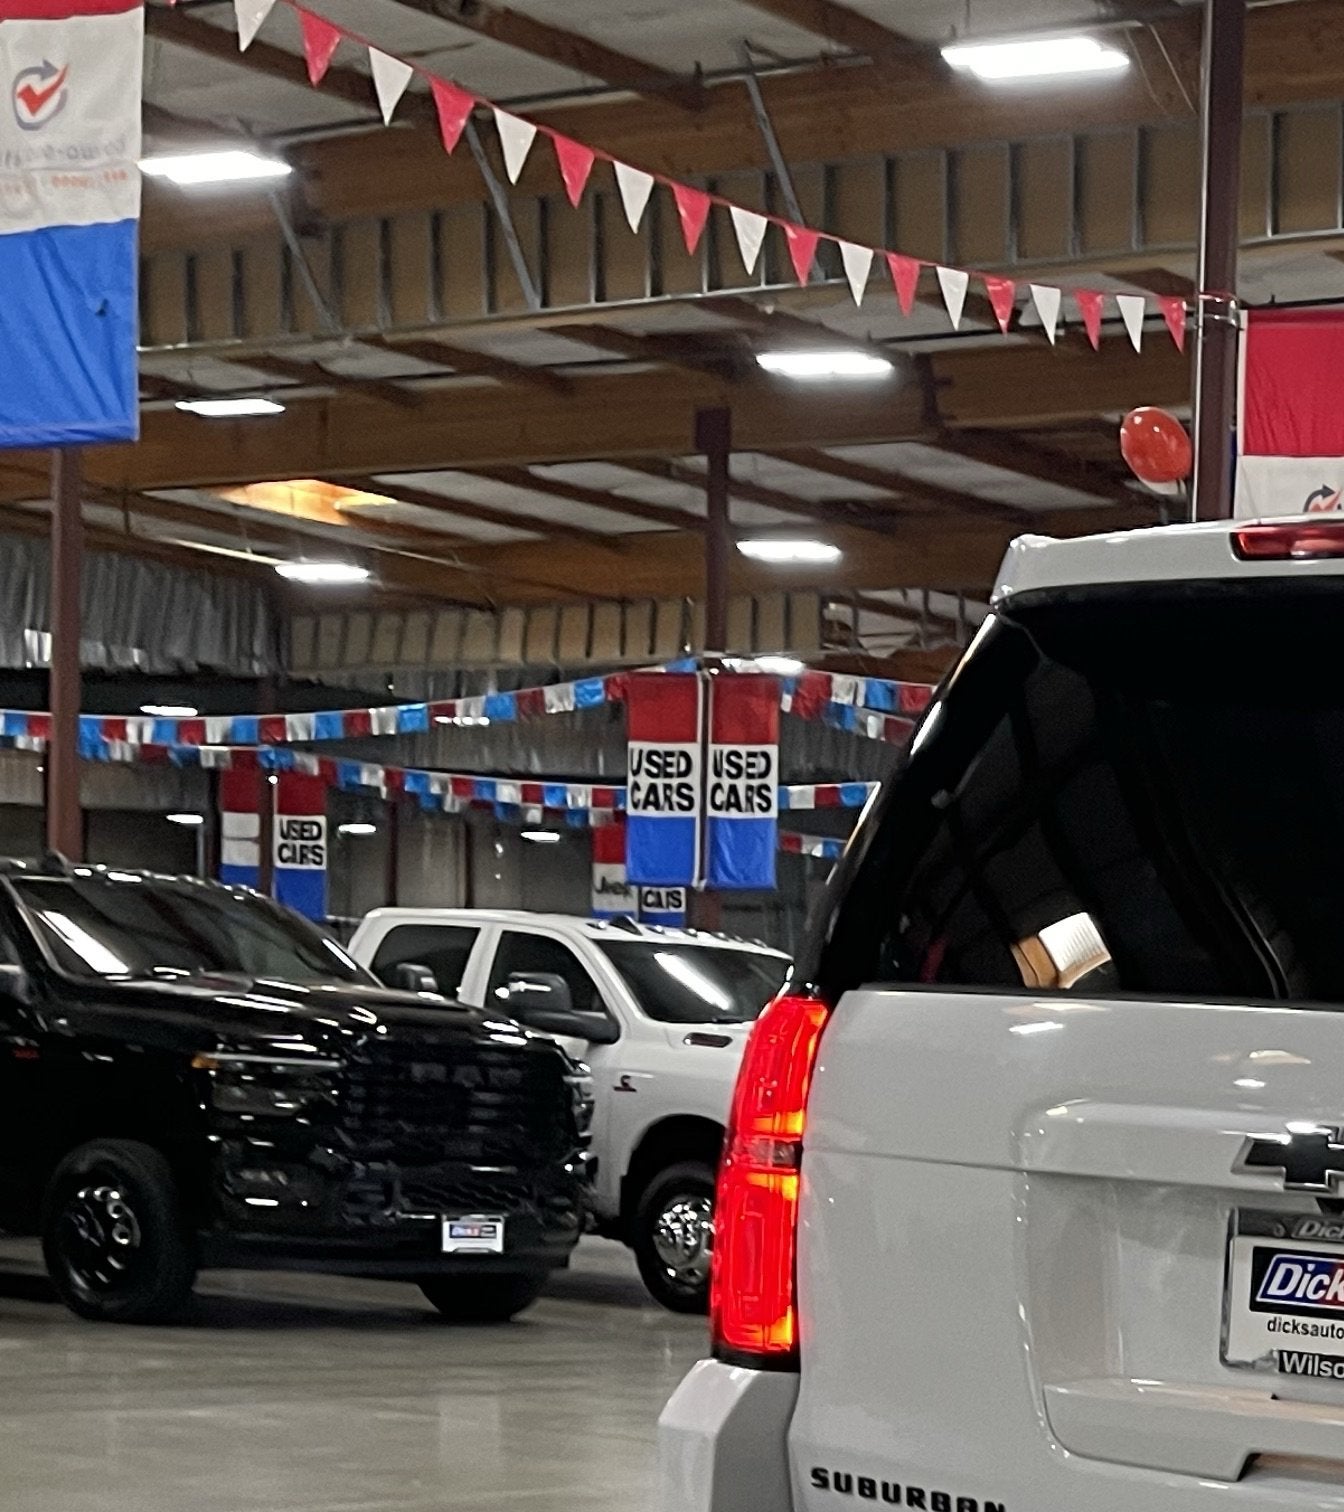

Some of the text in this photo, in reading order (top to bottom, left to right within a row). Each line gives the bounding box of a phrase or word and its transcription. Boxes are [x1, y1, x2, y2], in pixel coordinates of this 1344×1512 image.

[630, 748, 693, 779] USED
[713, 749, 772, 780] USED
[630, 780, 695, 812] CARS
[710, 782, 772, 814] CARS
[280, 819, 322, 840] USED
